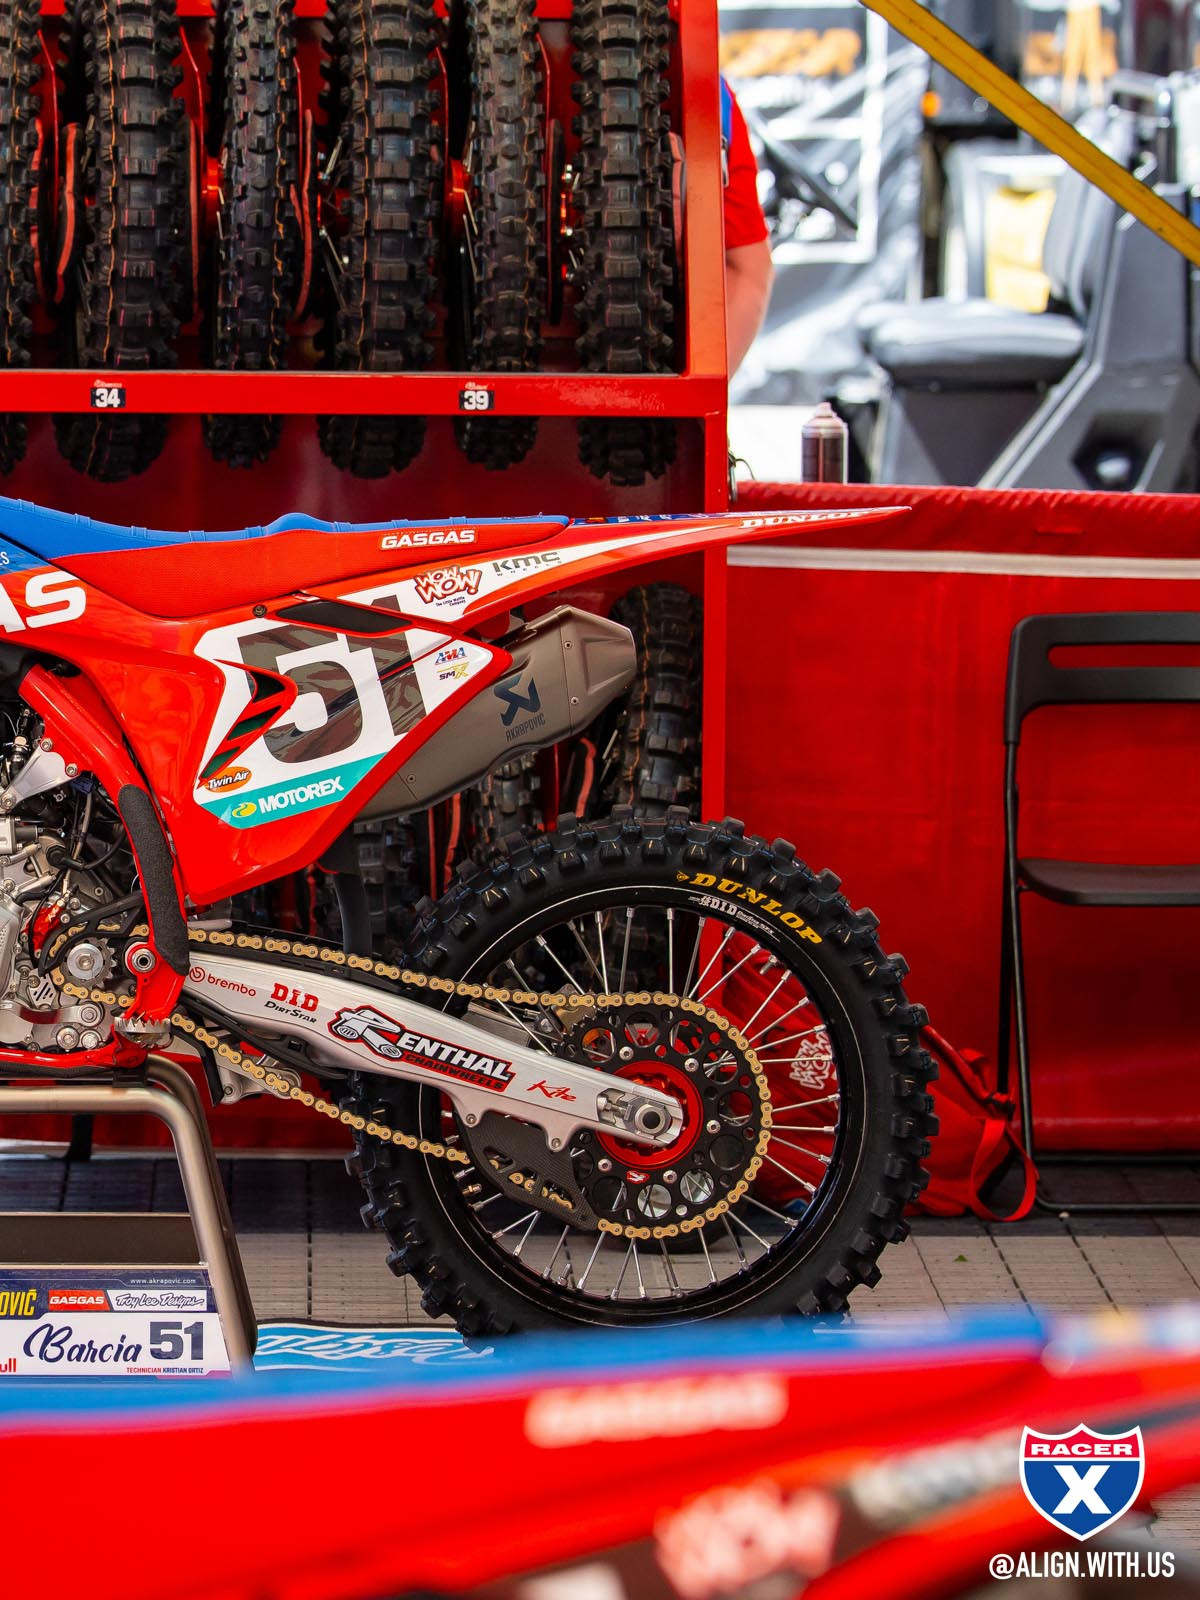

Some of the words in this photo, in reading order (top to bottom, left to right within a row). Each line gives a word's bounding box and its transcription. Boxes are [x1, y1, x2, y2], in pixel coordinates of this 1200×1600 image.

[95, 388, 120, 408] 34
[463, 390, 489, 410] 39
[739, 511, 869, 529] DUNLOP
[380, 530, 475, 549] GASGAS
[414, 565, 460, 588] WOW
[237, 594, 428, 764] 51
[208, 777, 233, 790] Twin
[234, 770, 249, 782] Air
[257, 775, 345, 814] MOTOREX
[689, 871, 824, 945] DUNLOP
[207, 973, 257, 996] brembo
[130, 1278, 197, 1286] www.akrapovic.com
[50, 1296, 105, 1305] GASGAS
[116, 1293, 139, 1308] Troy
[140, 1293, 160, 1306] Lee
[160, 1292, 204, 1308] Designs
[23, 1322, 143, 1364] Barcia
[149, 1321, 204, 1361] 51
